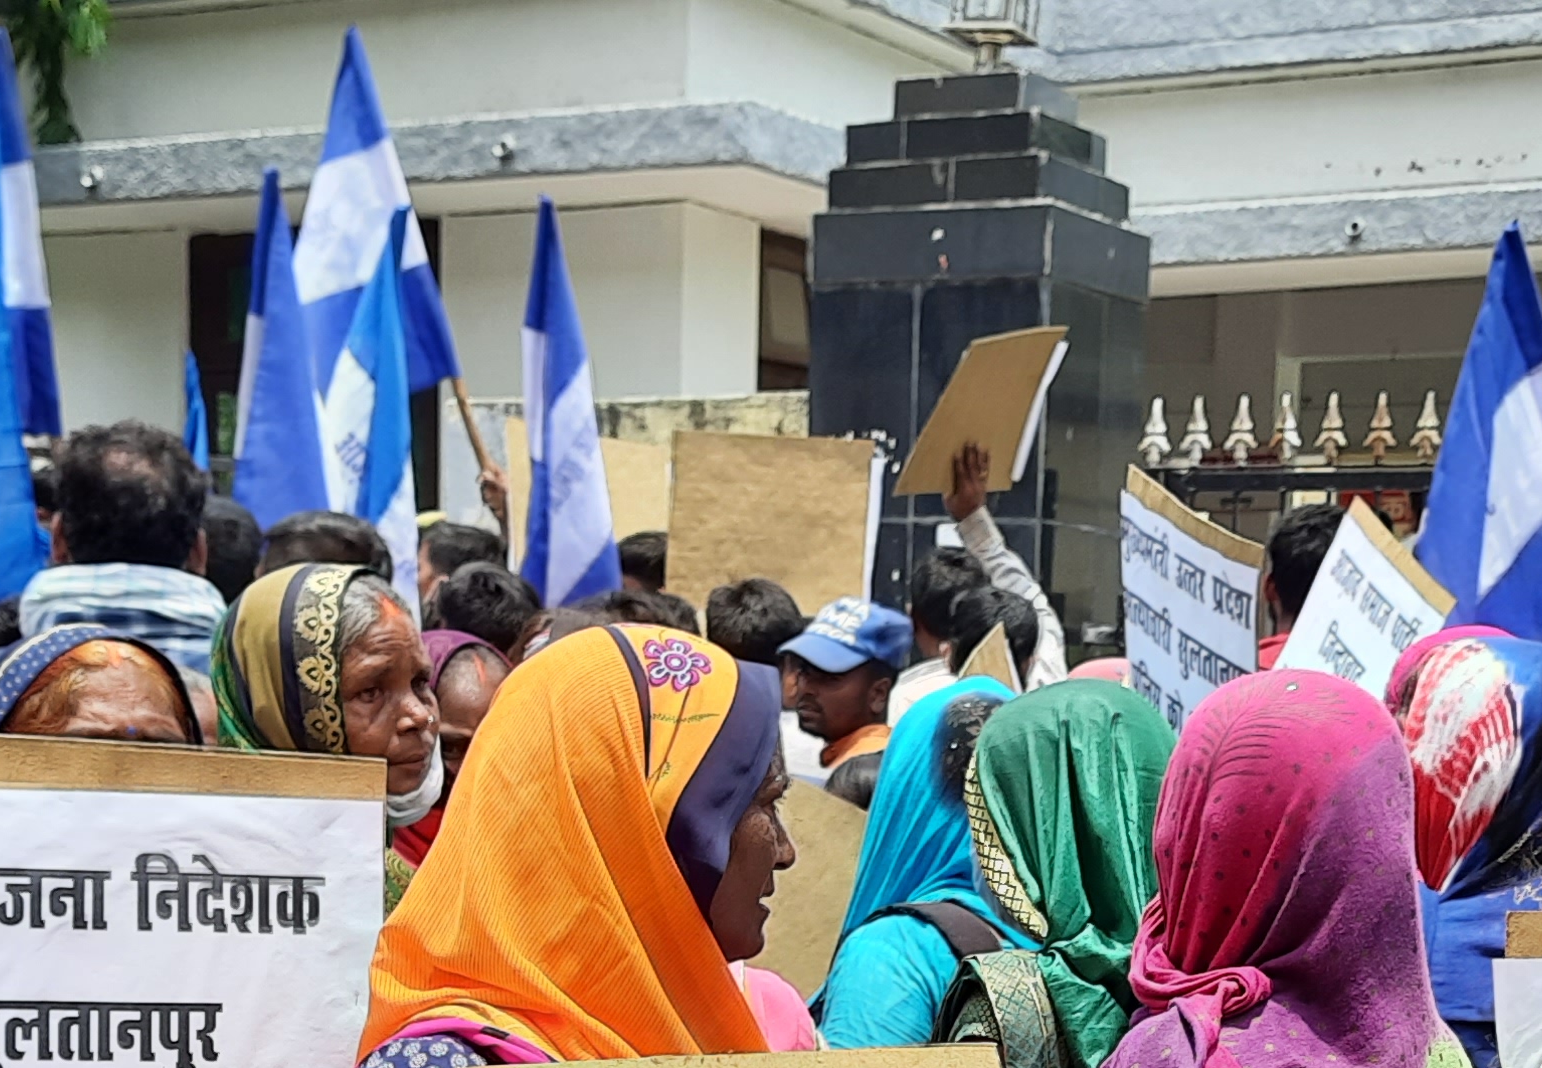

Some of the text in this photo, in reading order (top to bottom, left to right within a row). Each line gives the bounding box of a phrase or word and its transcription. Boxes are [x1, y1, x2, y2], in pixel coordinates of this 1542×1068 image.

[1174, 553, 1206, 603] उत्तर
[1212, 570, 1252, 629] प्रदेश
[131, 853, 325, 934] निदेशक
